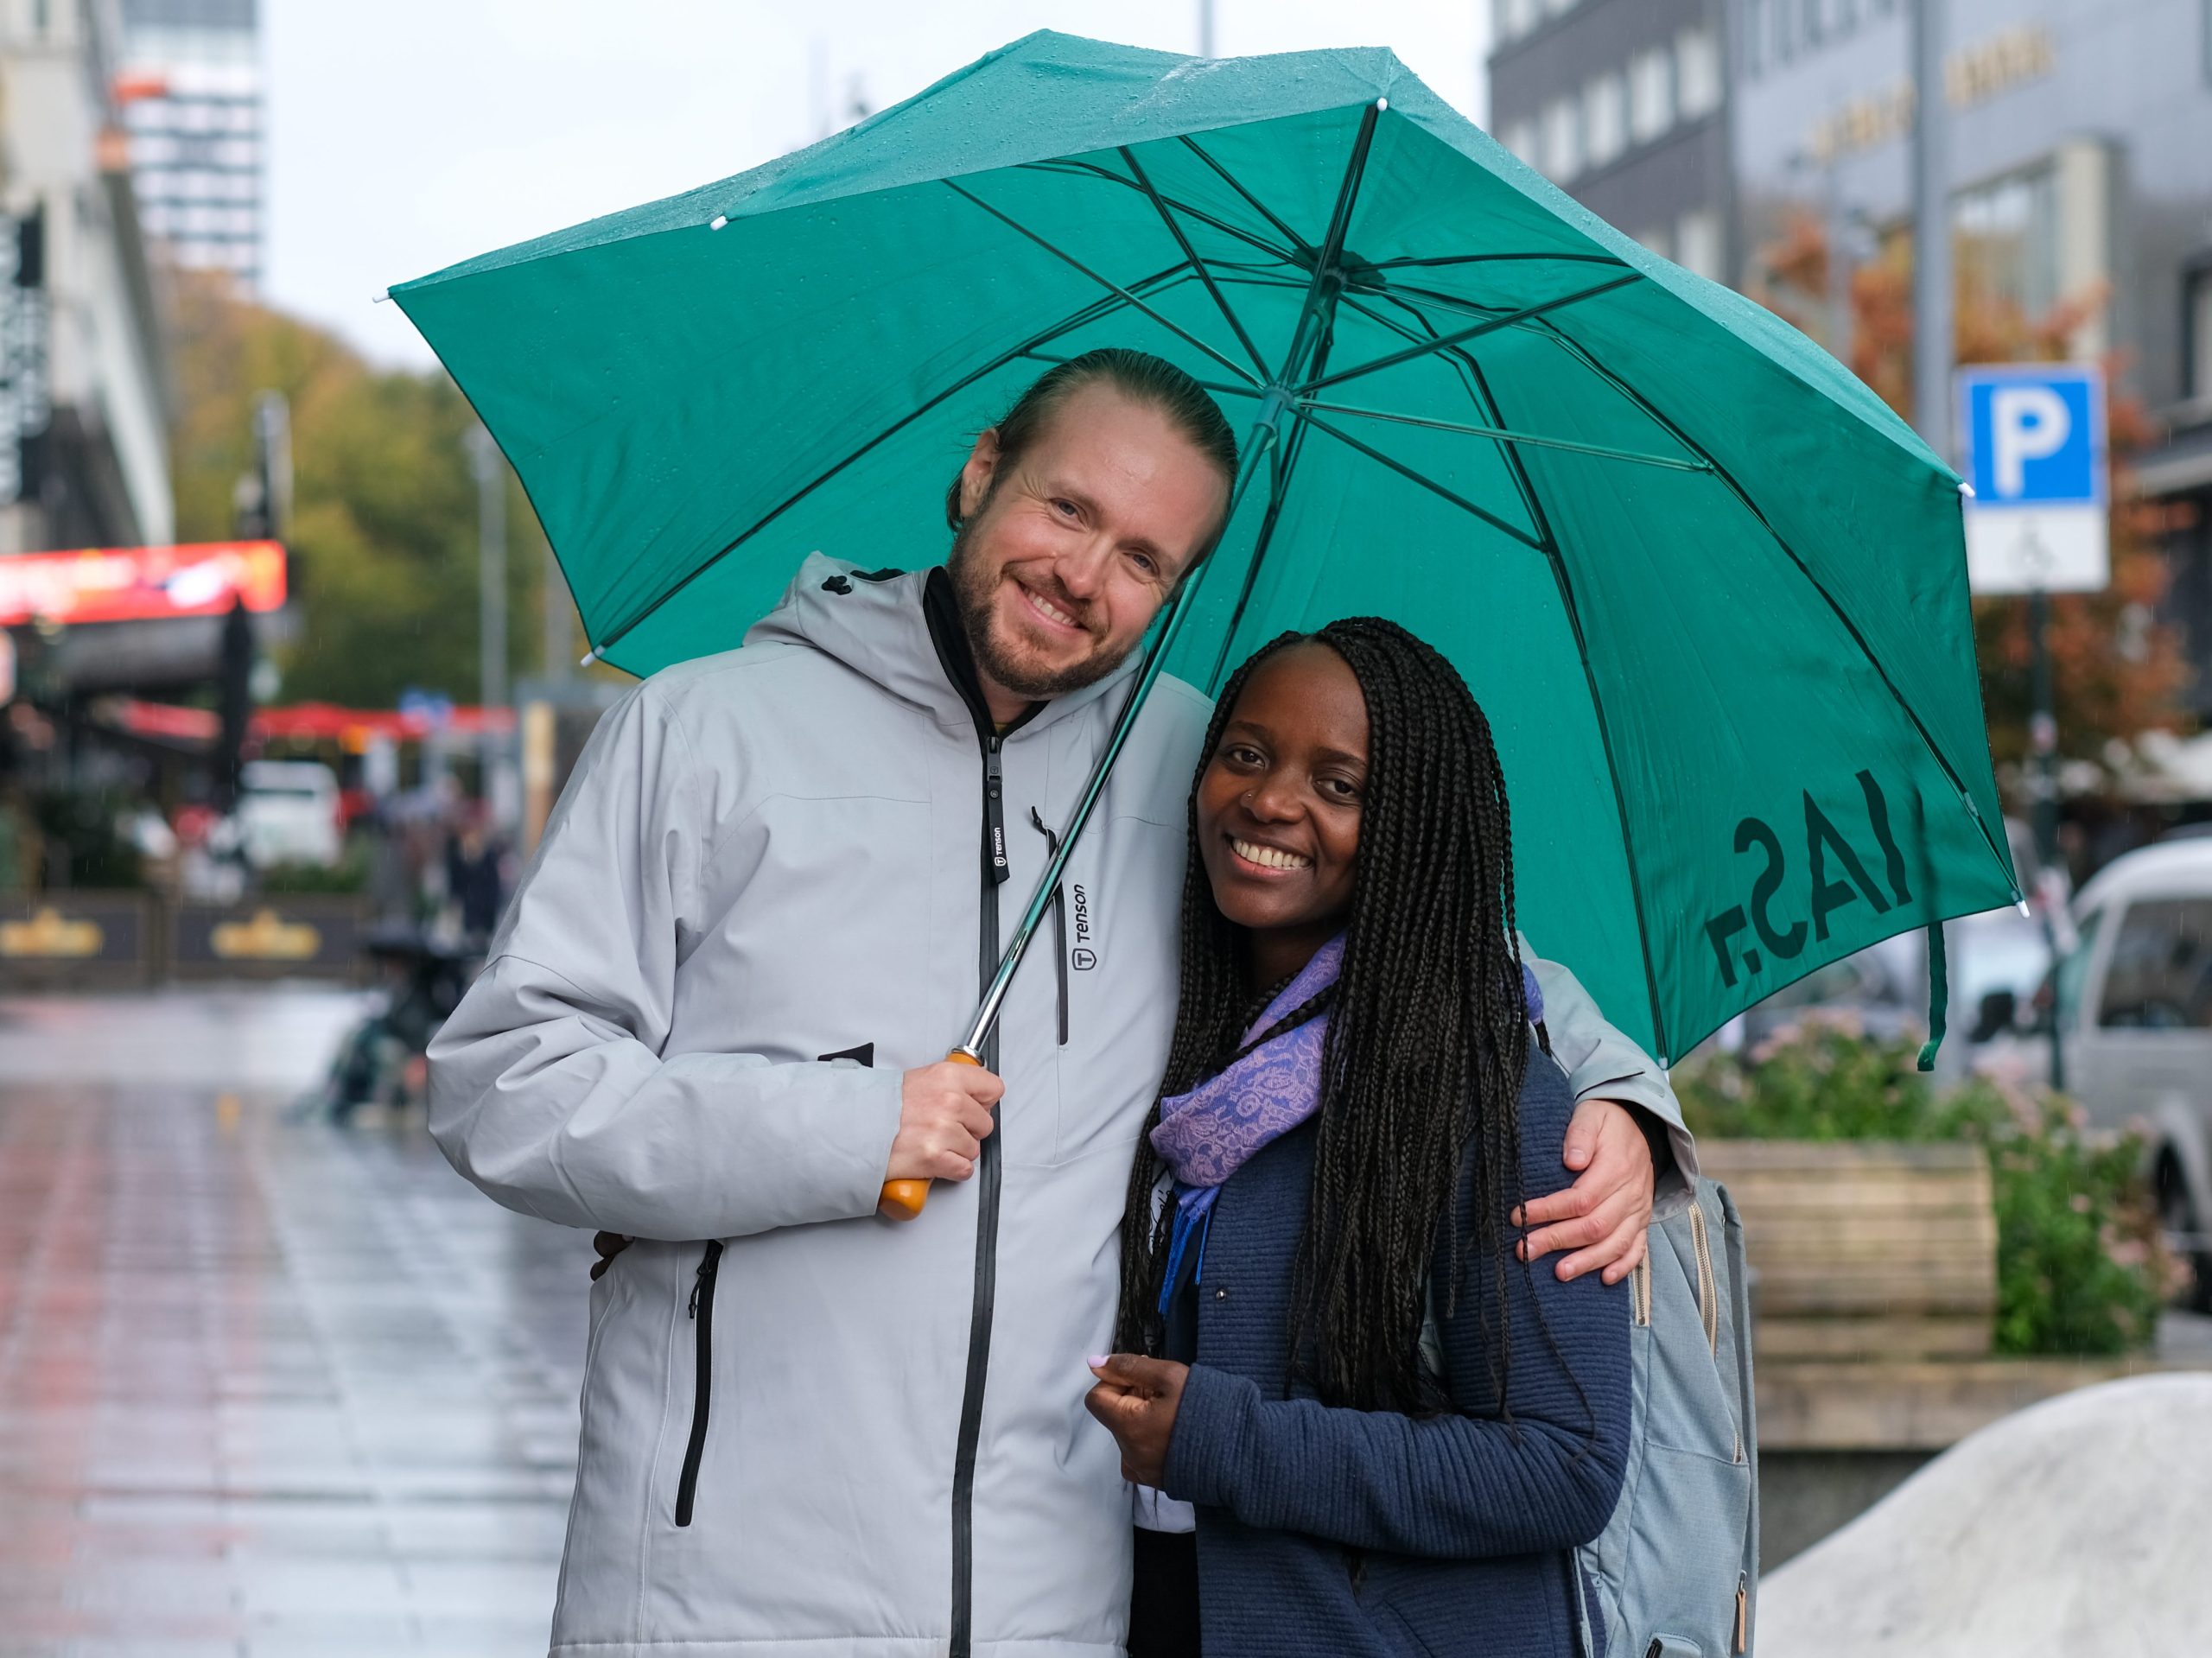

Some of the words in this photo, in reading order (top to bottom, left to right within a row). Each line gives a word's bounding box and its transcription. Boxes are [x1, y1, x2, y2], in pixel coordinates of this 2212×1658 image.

[1990, 385, 2071, 498] P
[995, 827, 1003, 855] Tenson
[1074, 884, 1090, 943] Tenson
